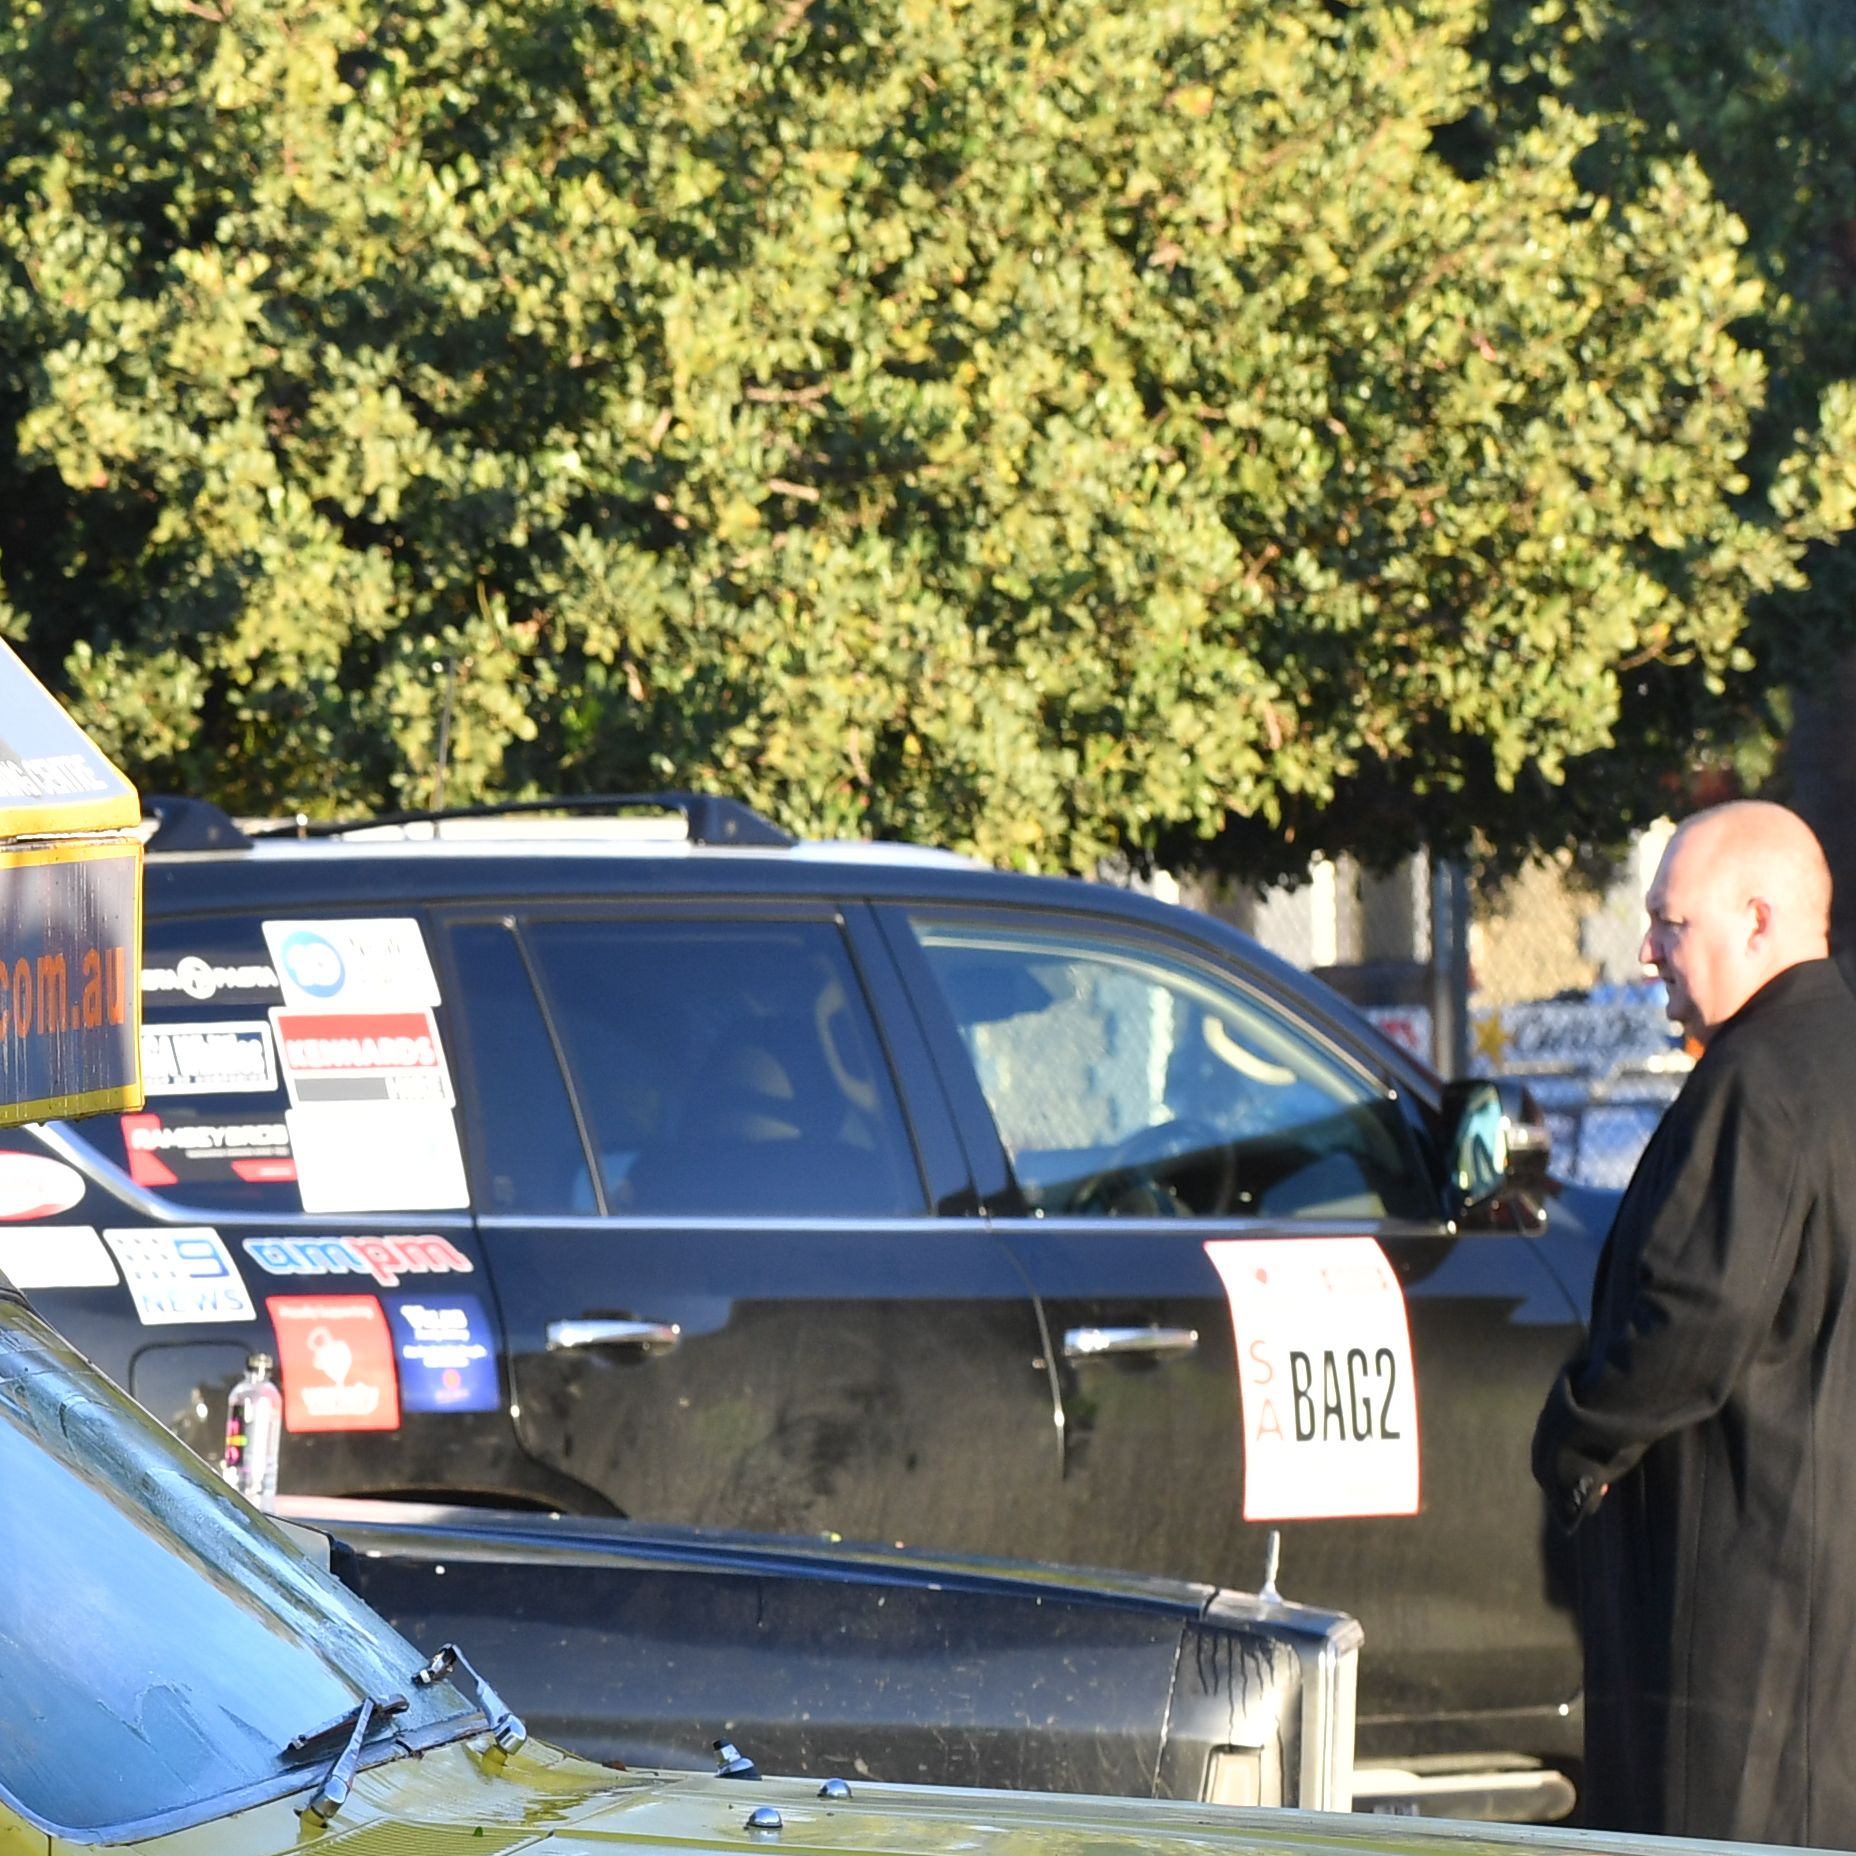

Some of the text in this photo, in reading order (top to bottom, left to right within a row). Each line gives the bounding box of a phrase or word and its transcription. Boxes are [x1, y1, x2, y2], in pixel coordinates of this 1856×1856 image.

[174, 1239, 230, 1279] 9
[141, 1289, 244, 1313] NEWS
[1289, 1347, 1401, 1442] BAG2
